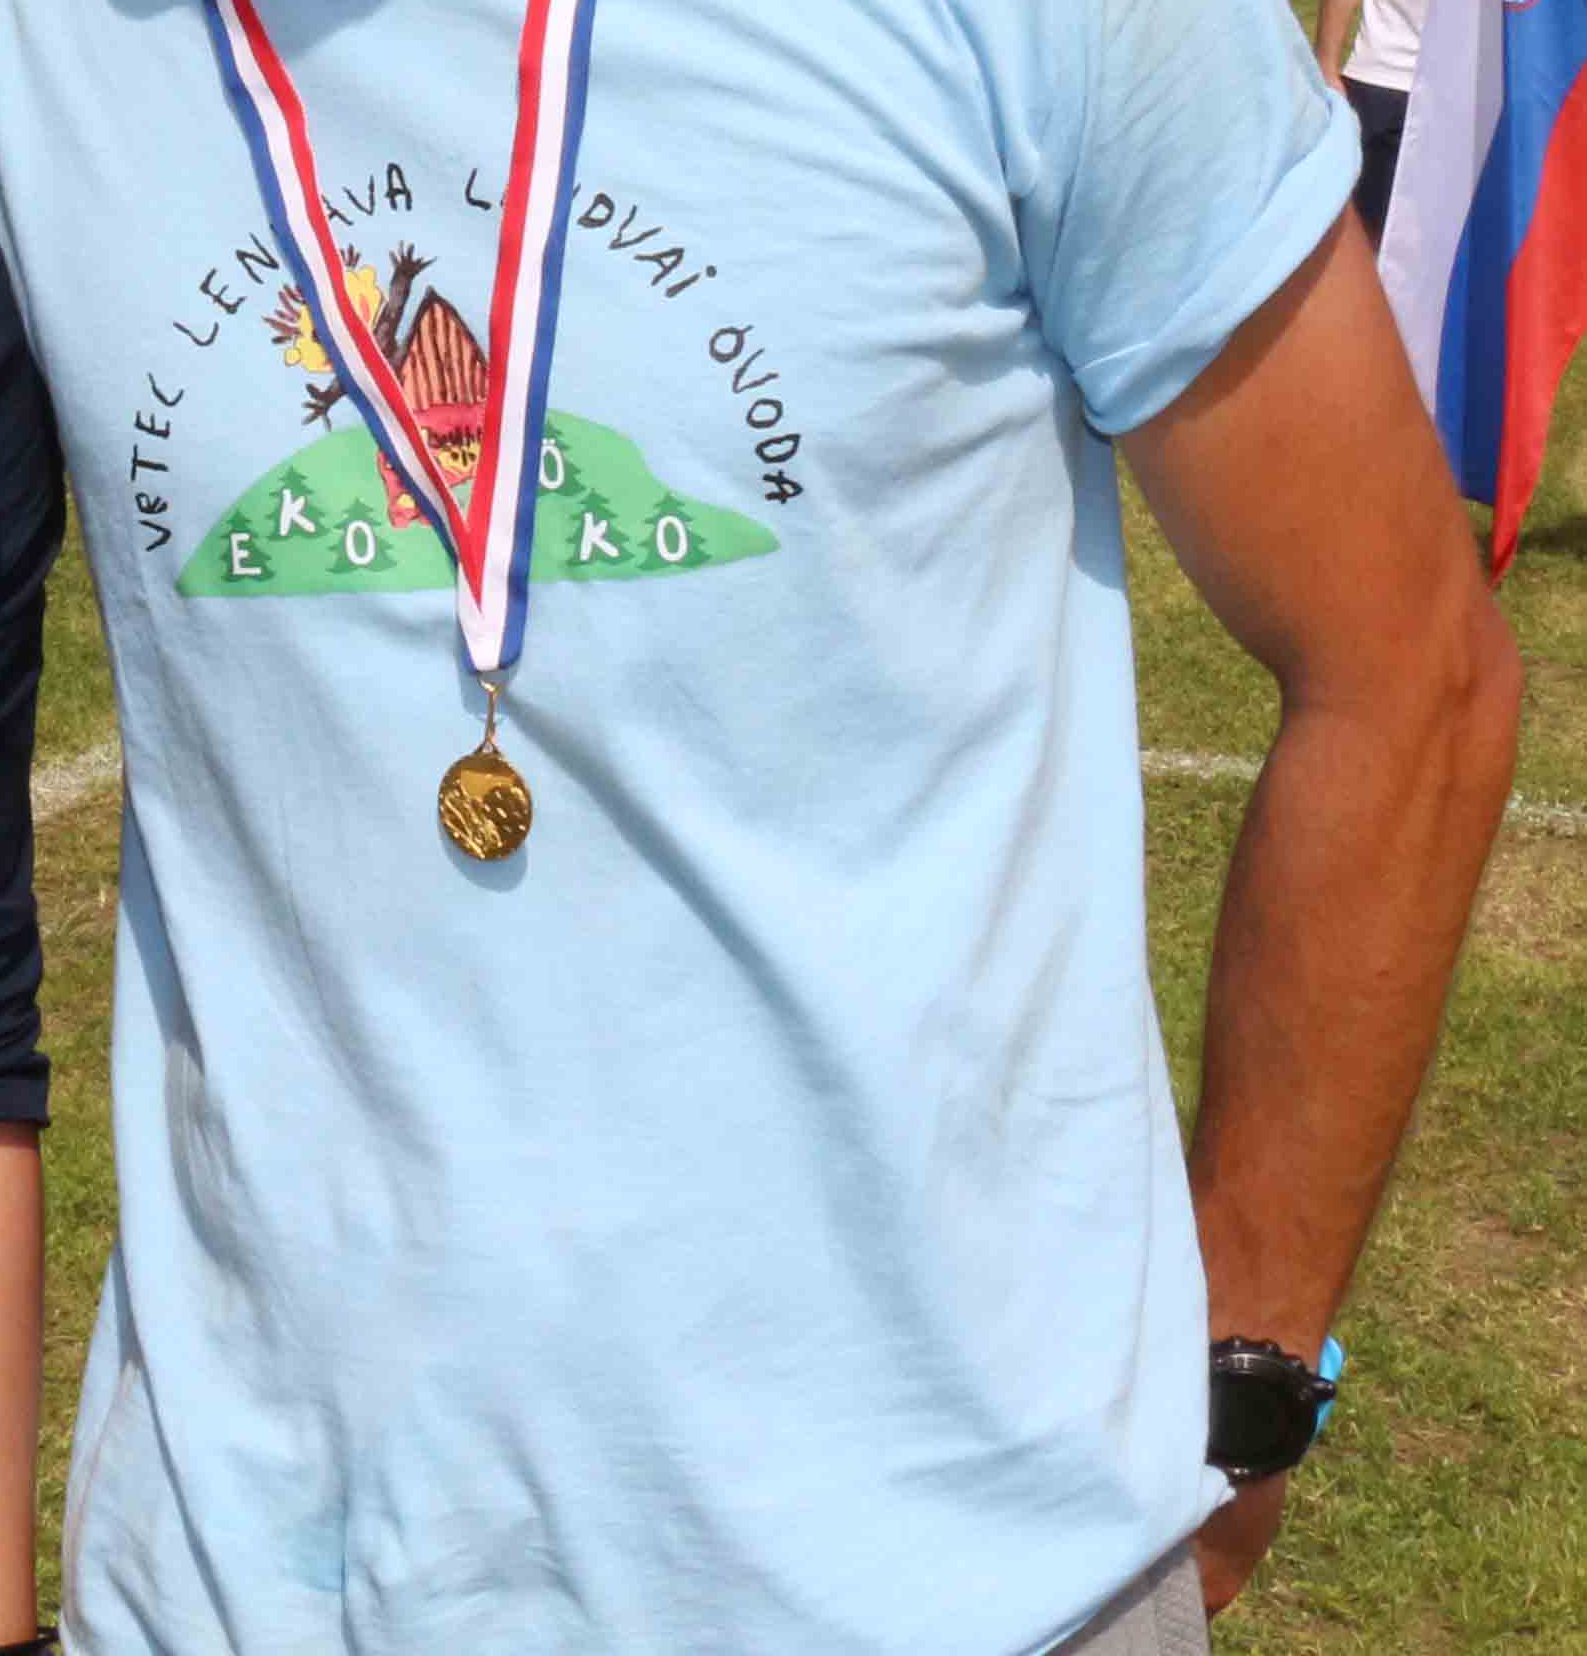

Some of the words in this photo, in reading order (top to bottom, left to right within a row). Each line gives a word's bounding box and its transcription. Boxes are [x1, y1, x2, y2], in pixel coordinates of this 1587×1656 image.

[129, 371, 185, 553] VRTEC
[172, 162, 414, 347] LENAVA
[230, 488, 378, 576] EKO
[538, 438, 689, 562] ÖKO
